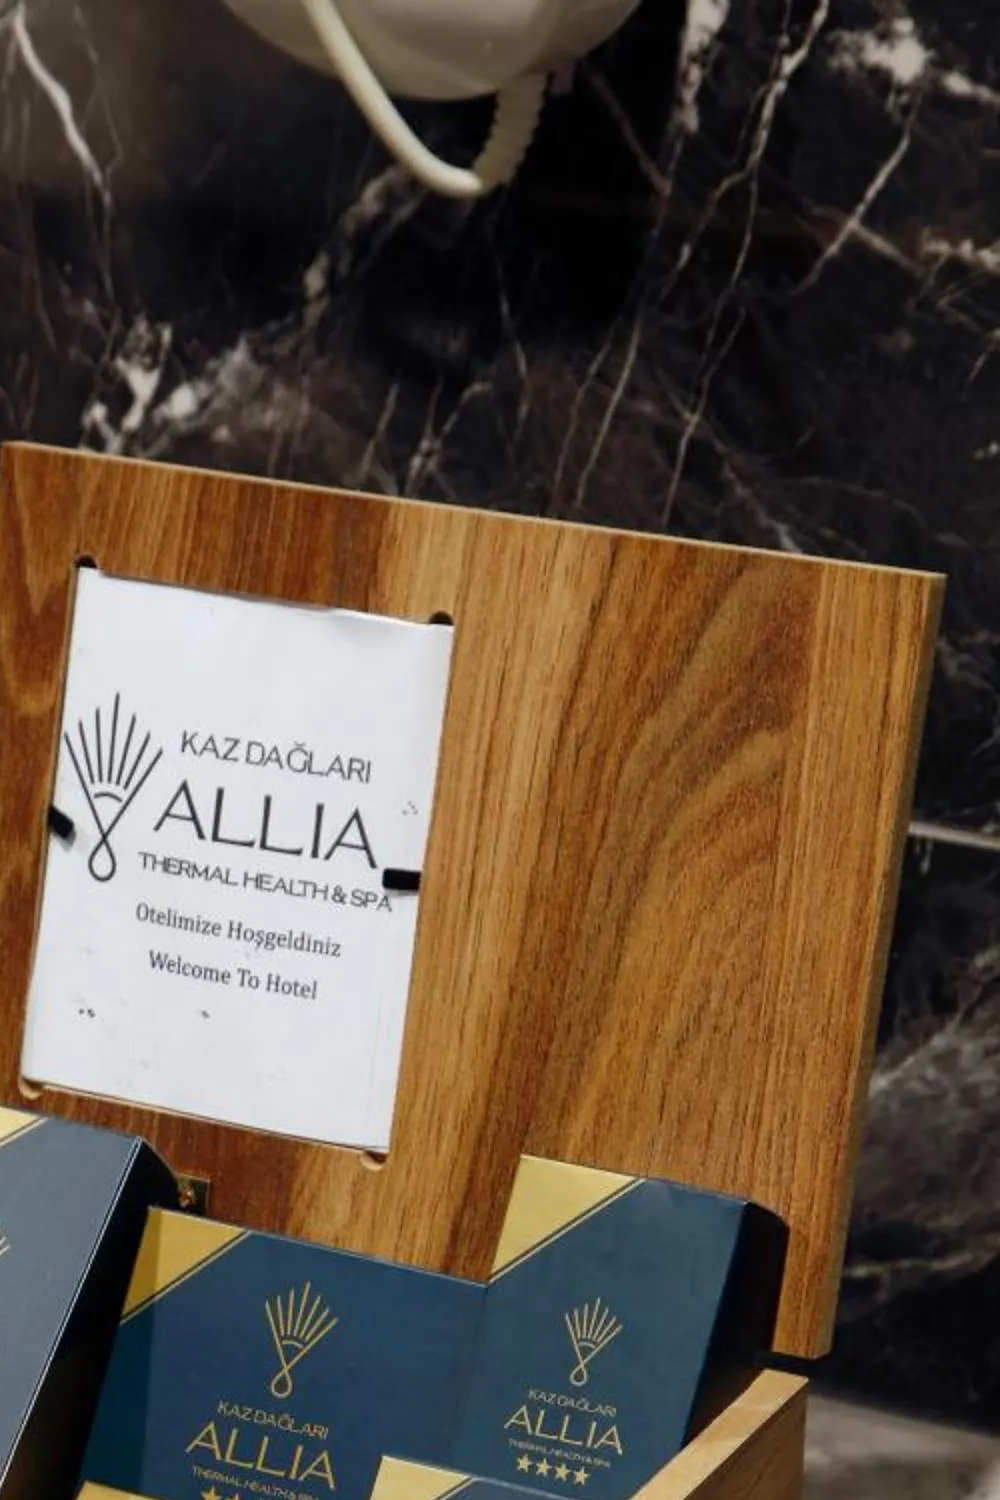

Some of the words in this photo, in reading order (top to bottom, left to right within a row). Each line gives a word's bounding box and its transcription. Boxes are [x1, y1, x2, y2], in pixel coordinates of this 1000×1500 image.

[181, 730, 239, 763] KAZ
[245, 739, 372, 784] DAĞLARI
[153, 778, 378, 869] ALLIA
[138, 851, 238, 887] THERMAL
[243, 872, 329, 901] HEALTH
[331, 886, 348, 905] &
[351, 888, 393, 913] SPA
[135, 902, 222, 937] Otelimize
[226, 920, 342, 957] Hoşgeldiniz
[149, 950, 231, 985] Welcome
[237, 967, 260, 990] To
[265, 972, 318, 1000] Hotel
[185, 1421, 336, 1490] ALLIA
[503, 1404, 623, 1455] ALLIA
